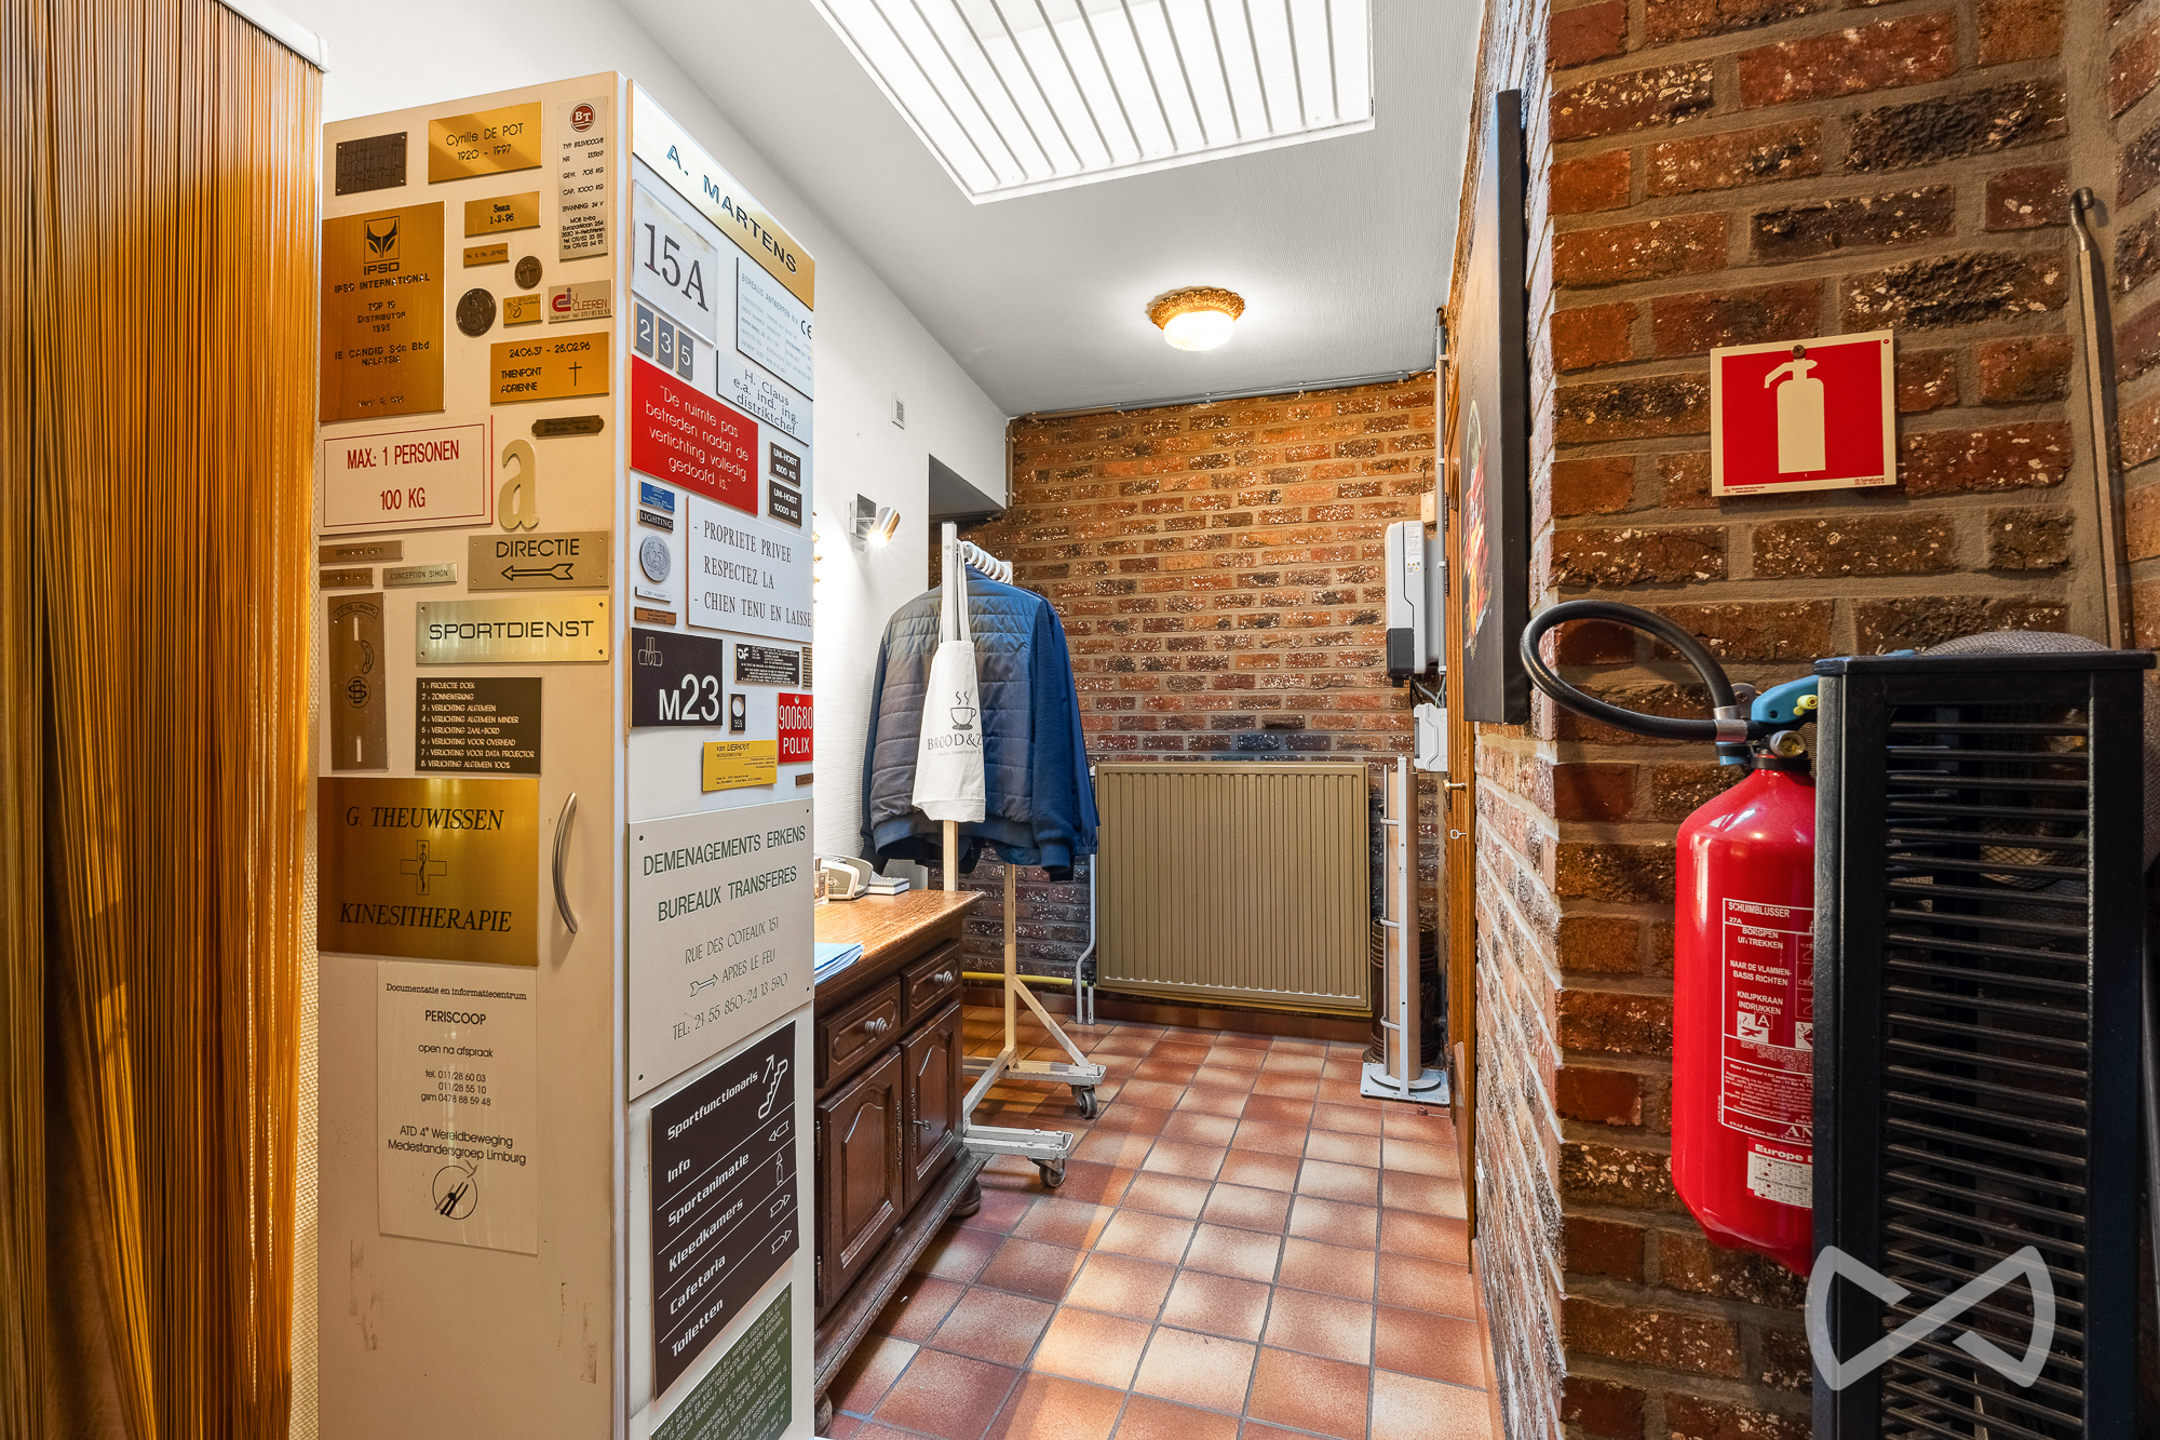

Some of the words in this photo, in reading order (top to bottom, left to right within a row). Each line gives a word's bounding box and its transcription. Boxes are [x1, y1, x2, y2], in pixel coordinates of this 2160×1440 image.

[576, 111, 591, 121] BT
[484, 127, 497, 140] DE
[503, 123, 523, 136] POT
[458, 149, 479, 161] 1920
[493, 144, 511, 155] 1997
[667, 144, 689, 176] A.
[703, 174, 797, 274] MARTENS
[364, 262, 399, 276] IPSO
[644, 222, 709, 312] 15A
[335, 283, 354, 293] IPSO
[359, 273, 430, 290] INTERNATIONAL
[368, 302, 383, 311] TOP
[388, 300, 395, 309] 10
[572, 299, 607, 311] CLEEREN
[349, 346, 383, 358] CANDID
[389, 344, 406, 354] Sdn
[412, 341, 430, 351] Bhd
[362, 355, 401, 366] MALAYSIA
[501, 367, 542, 379] THIENPONT
[501, 382, 537, 393] ADRIENNE
[745, 369, 755, 385] H.
[762, 381, 789, 405] Claus
[733, 378, 751, 395] e.a.
[758, 390, 776, 410] ind.
[782, 405, 798, 425] ing.
[685, 402, 717, 426] ruimte
[721, 420, 739, 438] pas
[737, 393, 795, 434] distriktchef
[645, 400, 698, 437] betreden
[702, 430, 732, 453] nadat
[735, 446, 749, 461] de
[383, 446, 388, 466] 1
[395, 439, 459, 465] PERSONEN
[649, 426, 705, 464] verlichting
[709, 454, 747, 482] volledig
[668, 457, 715, 485] gedoofd
[380, 489, 401, 510] 100
[409, 487, 425, 508] KG
[640, 510, 673, 528] LIGHTING
[791, 509, 798, 519] KG
[496, 538, 580, 558] DIRECTIE
[704, 520, 756, 552] PROPRIETE
[761, 538, 792, 563] PRIVEE
[390, 571, 426, 580] CONCEPTION
[429, 570, 448, 578] SIMON
[704, 555, 758, 586] RESPECTEZ
[763, 571, 774, 589] LA
[704, 591, 736, 613] CHIEN
[742, 599, 765, 619] TENU
[771, 605, 781, 622] EN
[786, 608, 812, 628] LAISSE
[429, 620, 594, 640] SPORTDIENST
[431, 704, 465, 712] VERLICHTING
[467, 704, 496, 712] ALGEMEEN
[780, 705, 812, 730] 900680
[431, 715, 465, 723] VERLICHTING
[467, 738, 485, 746] VOOR
[783, 737, 810, 754] POLIX
[502, 750, 535, 758] PROJECTOR
[346, 806, 362, 827] G.
[371, 807, 505, 830] THEUWISSEN
[643, 834, 761, 877] DEMENAGEMENTS
[767, 825, 806, 848] ERKENS
[658, 885, 721, 922] BUREAUX
[728, 866, 797, 900] TRANSFERES
[339, 902, 512, 932] KINESITHERAPIE
[1728, 902, 1790, 918] SCHUIMBLUSSER
[685, 944, 703, 965] RUE
[707, 937, 723, 956] DES
[728, 921, 766, 948] COTEAUX
[1742, 927, 1778, 939] BORGPEN
[722, 960, 747, 984] APRES
[750, 955, 759, 971] LE
[762, 948, 775, 966] FEU
[1730, 960, 1746, 970] NAAR
[1748, 963, 1756, 971] DE
[1758, 965, 1792, 976] VLAMMEN-
[1733, 970, 1754, 981] BASIS
[1756, 974, 1788, 986] RICHTEN
[386, 983, 439, 995] Documentatie
[452, 988, 527, 1000] informatiecentrum
[1737, 990, 1783, 1005] KNIJPKRAAN
[673, 1022, 690, 1040] TEL:
[695, 1012, 704, 1030] 21
[708, 1005, 720, 1023] 55
[771, 972, 788, 992] 590
[1738, 1001, 1781, 1015] INDRUKKEN
[425, 1010, 486, 1025] PERISCOOP
[1758, 1015, 1769, 1027] A
[418, 1044, 441, 1054] open
[443, 1046, 454, 1054] na
[456, 1047, 493, 1058] afspraak
[438, 1070, 463, 1080] 011/28
[465, 1073, 474, 1081] 60
[476, 1074, 486, 1082] 03
[438, 1082, 463, 1092] 011/28
[465, 1085, 475, 1093] 55
[478, 1086, 487, 1094] 10
[421, 1093, 436, 1103] gsm
[470, 1097, 480, 1105] 59
[481, 1098, 491, 1106] 48
[667, 1071, 758, 1140] Sportfunctionaris
[400, 1125, 418, 1137] ATD
[431, 1128, 513, 1149] Wereldbeweging
[388, 1139, 484, 1160] Medestandersgroep
[487, 1149, 526, 1166] Limburg
[1755, 1144, 1803, 1161] Europe
[667, 1158, 690, 1183] Info
[669, 1153, 749, 1227] Sportanimatie
[669, 1199, 743, 1272] Kleedkamers
[670, 1255, 726, 1315] Cafetaria
[671, 1299, 723, 1357] Toiletten
